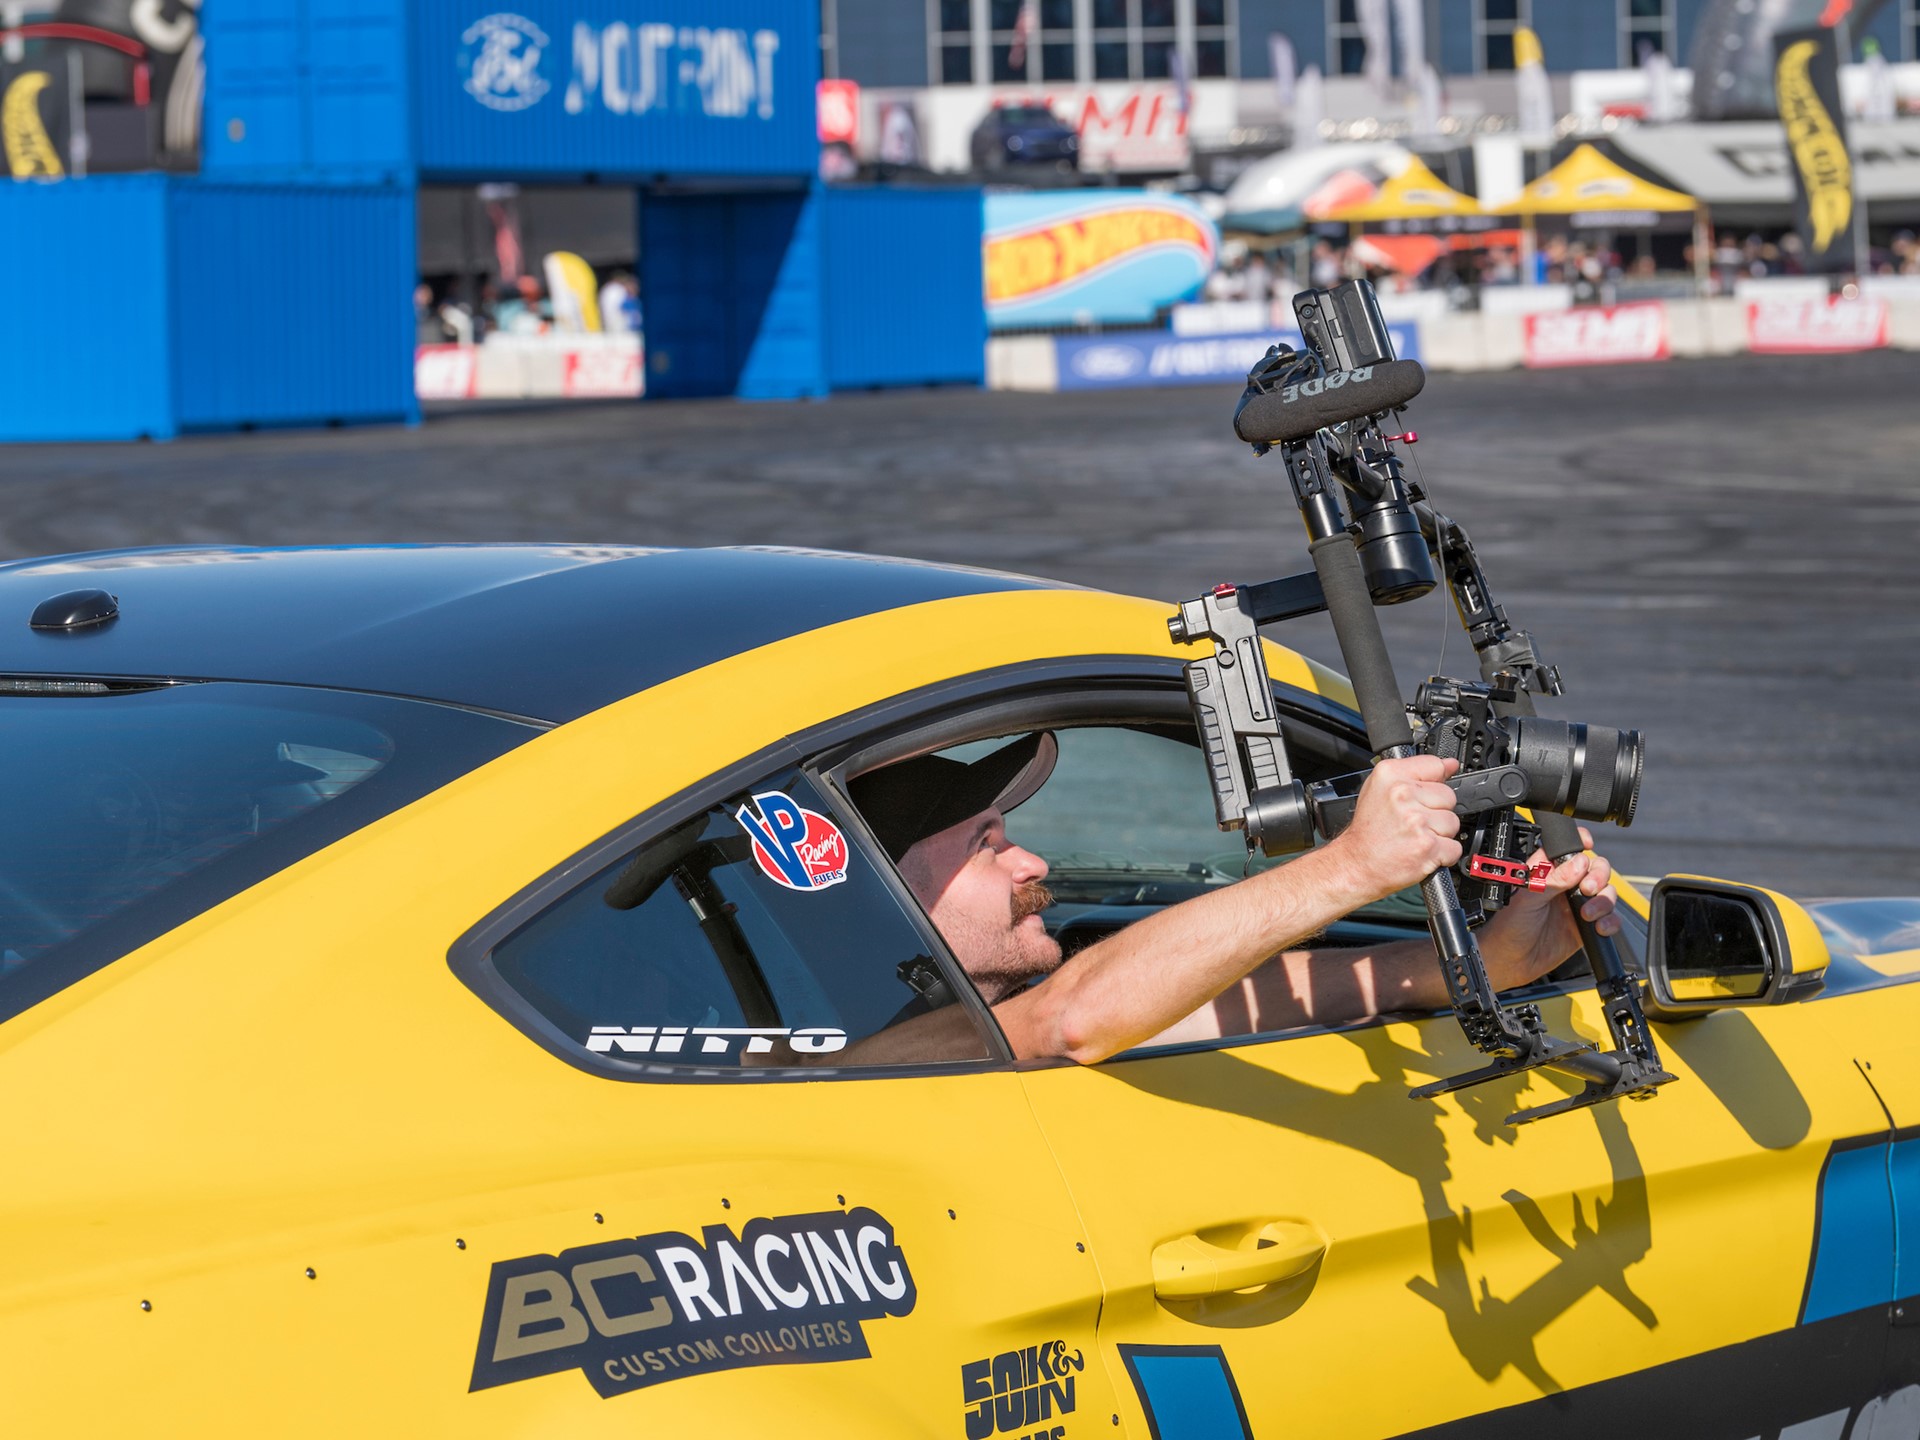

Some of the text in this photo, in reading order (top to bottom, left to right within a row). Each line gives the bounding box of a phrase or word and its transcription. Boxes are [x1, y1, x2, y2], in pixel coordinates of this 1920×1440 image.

[738, 793, 814, 888] VP
[801, 832, 839, 875] Racing
[813, 870, 844, 884] FUELS
[585, 1026, 847, 1053] NITTO
[604, 1320, 852, 1381] CUSTOM COILOVERS
